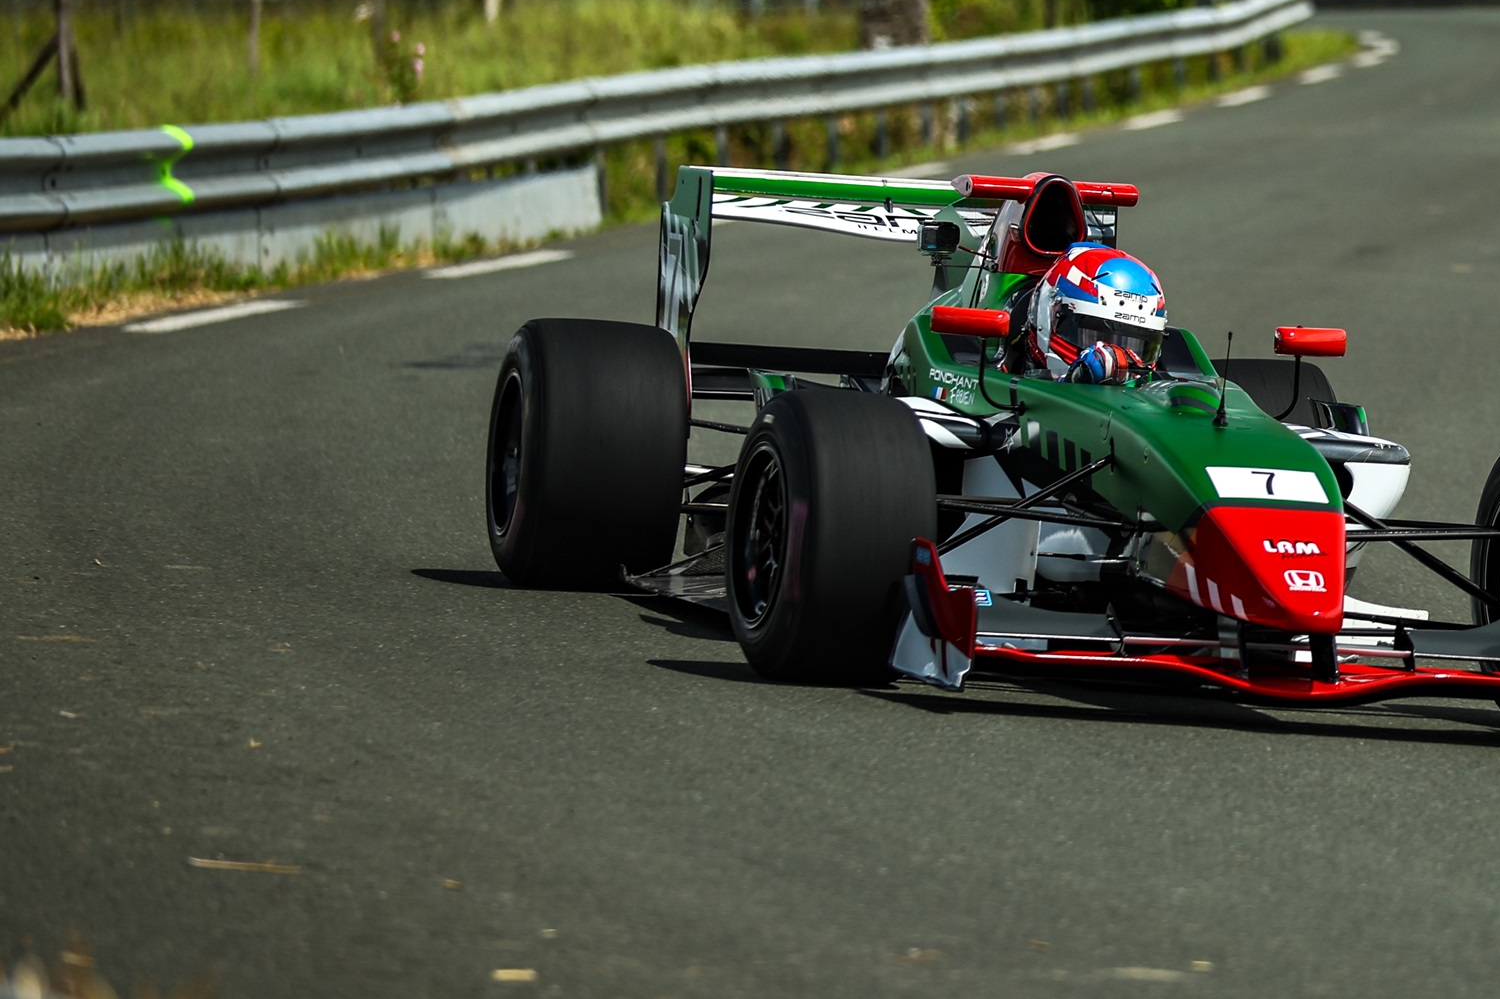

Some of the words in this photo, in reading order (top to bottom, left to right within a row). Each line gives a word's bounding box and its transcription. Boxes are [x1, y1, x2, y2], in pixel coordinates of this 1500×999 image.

[1114, 290, 1148, 304] zamp
[1114, 312, 1147, 324] zamp
[929, 368, 979, 390] PONCHANT
[1251, 471, 1275, 495] 7
[1263, 540, 1320, 555] LRM
